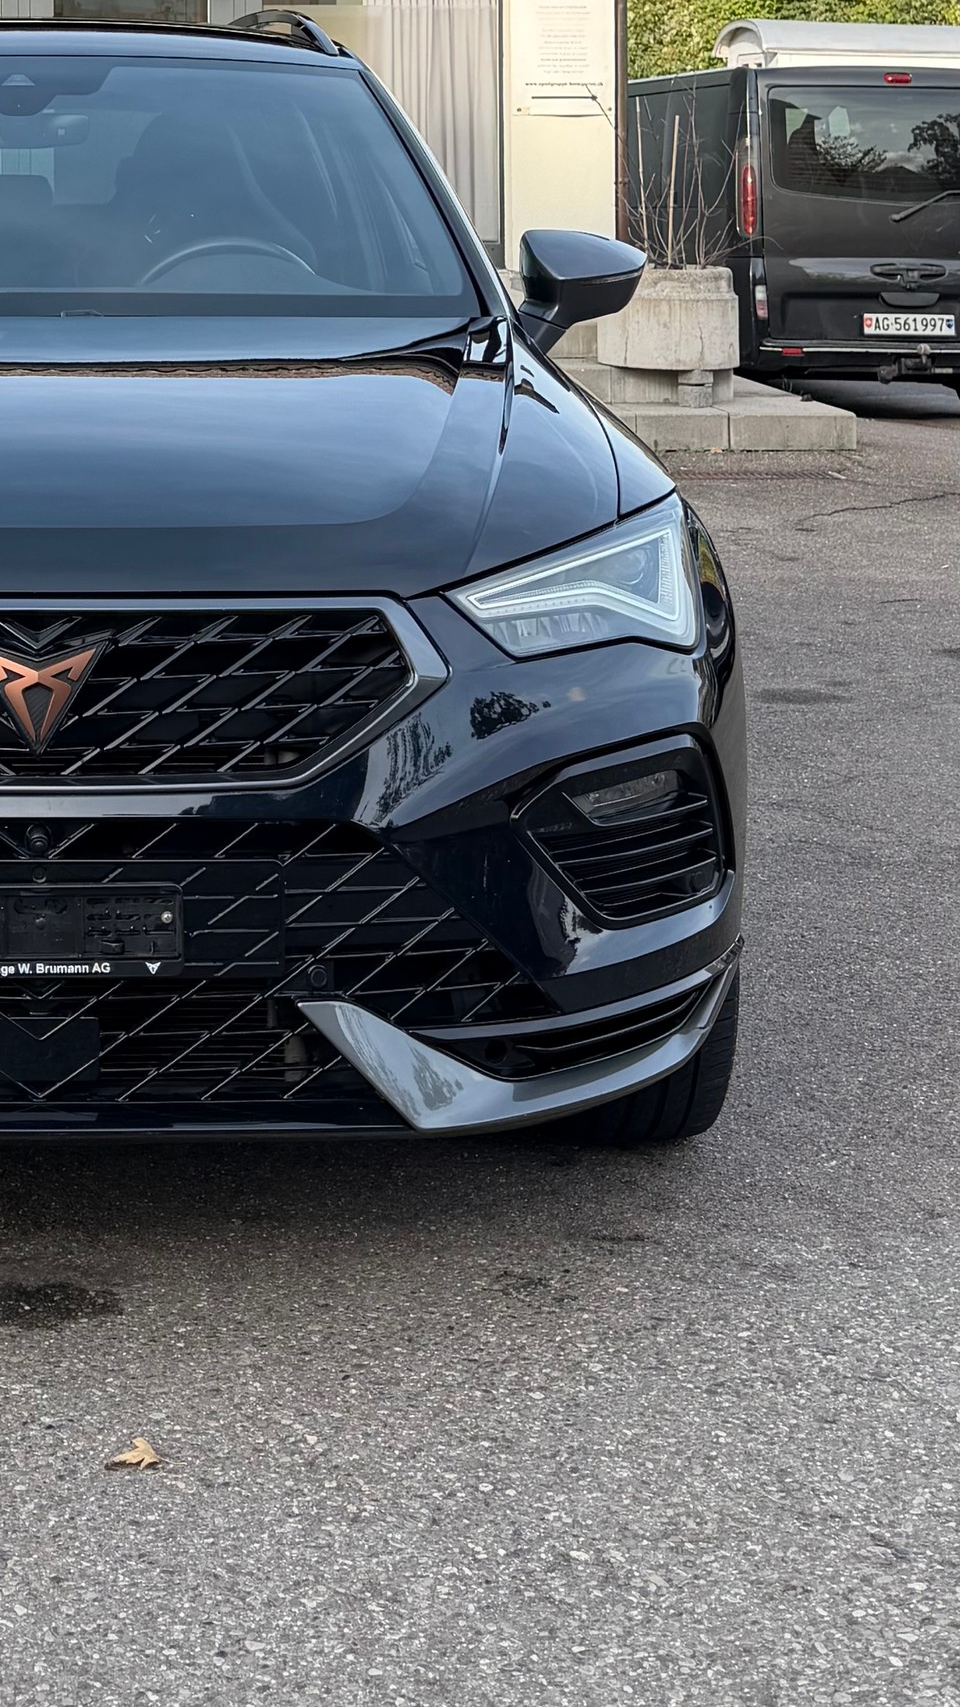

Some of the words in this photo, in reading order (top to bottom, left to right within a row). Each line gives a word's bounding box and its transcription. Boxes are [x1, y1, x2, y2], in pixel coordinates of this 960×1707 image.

[17, 963, 33, 974] W.
[36, 962, 89, 974] Brumann
[92, 962, 111, 973] AG
